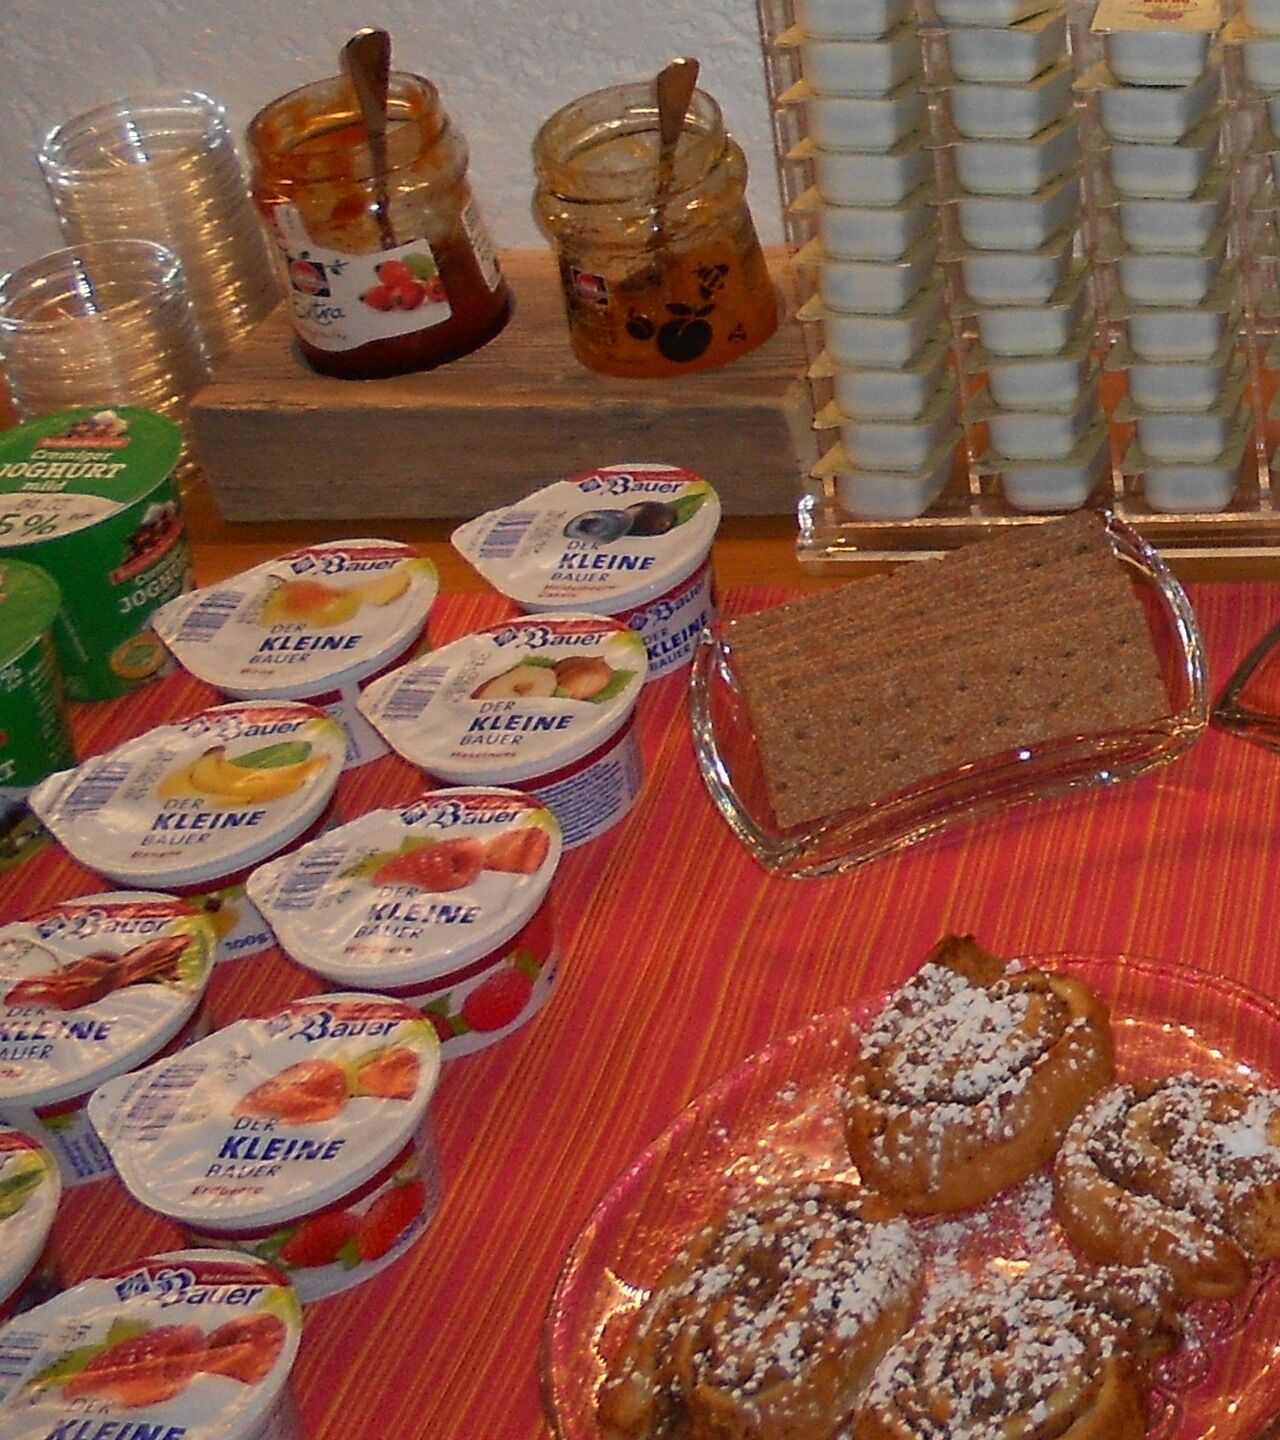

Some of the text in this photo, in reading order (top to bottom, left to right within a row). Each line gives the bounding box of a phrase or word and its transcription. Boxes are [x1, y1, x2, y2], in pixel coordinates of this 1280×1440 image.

[607, 475, 682, 496] Bauer
[314, 553, 400, 575] Bauer
[559, 553, 656, 571] KLEINE
[550, 572, 610, 583] BAUER
[270, 623, 307, 634] DER
[259, 635, 363, 652] KLEINE
[518, 626, 606, 650] Bauer
[248, 653, 312, 665] BAUER
[480, 700, 516, 713] DER
[468, 715, 575, 732] KLEINE
[459, 734, 524, 746] BAUER
[163, 798, 205, 810] DER
[152, 810, 267, 831] KLEINE
[430, 801, 521, 830] Bauer
[140, 832, 212, 847] BAUER
[368, 903, 481, 925] KLEINE
[353, 925, 425, 939] BAUER
[289, 1011, 402, 1043] Bauer
[233, 1115, 280, 1131] DER
[217, 1135, 346, 1161] KLEINE
[205, 1163, 283, 1179] BAUER
[44, 1419, 187, 1440] KLEINE
